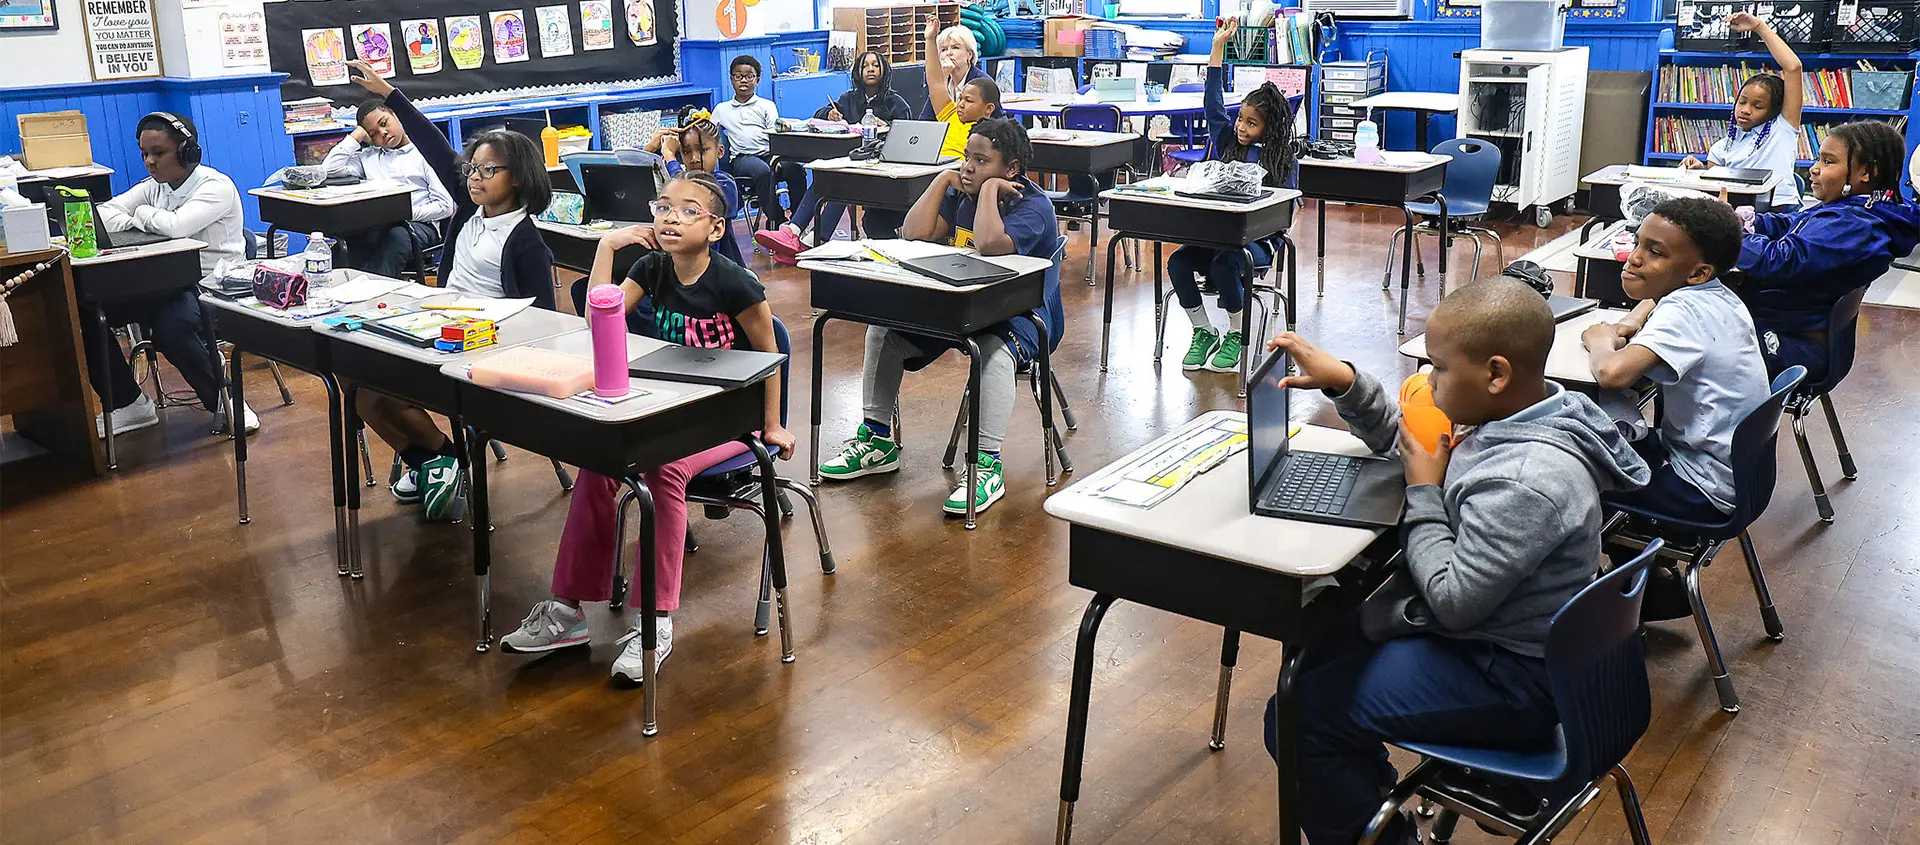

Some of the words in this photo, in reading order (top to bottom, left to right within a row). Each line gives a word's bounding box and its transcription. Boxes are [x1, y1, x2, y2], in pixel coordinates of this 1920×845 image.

[88, 0, 147, 15] REMEMBER
[1050, 0, 1072, 14] silly
[93, 16, 103, 27] I
[104, 16, 127, 26] love
[128, 18, 149, 29] you
[96, 31, 114, 39] YOU
[117, 30, 151, 38] MATTER
[99, 54, 103, 64] I
[106, 52, 154, 63] BELIEVE
[108, 63, 120, 73] IN
[123, 62, 148, 72] YOU
